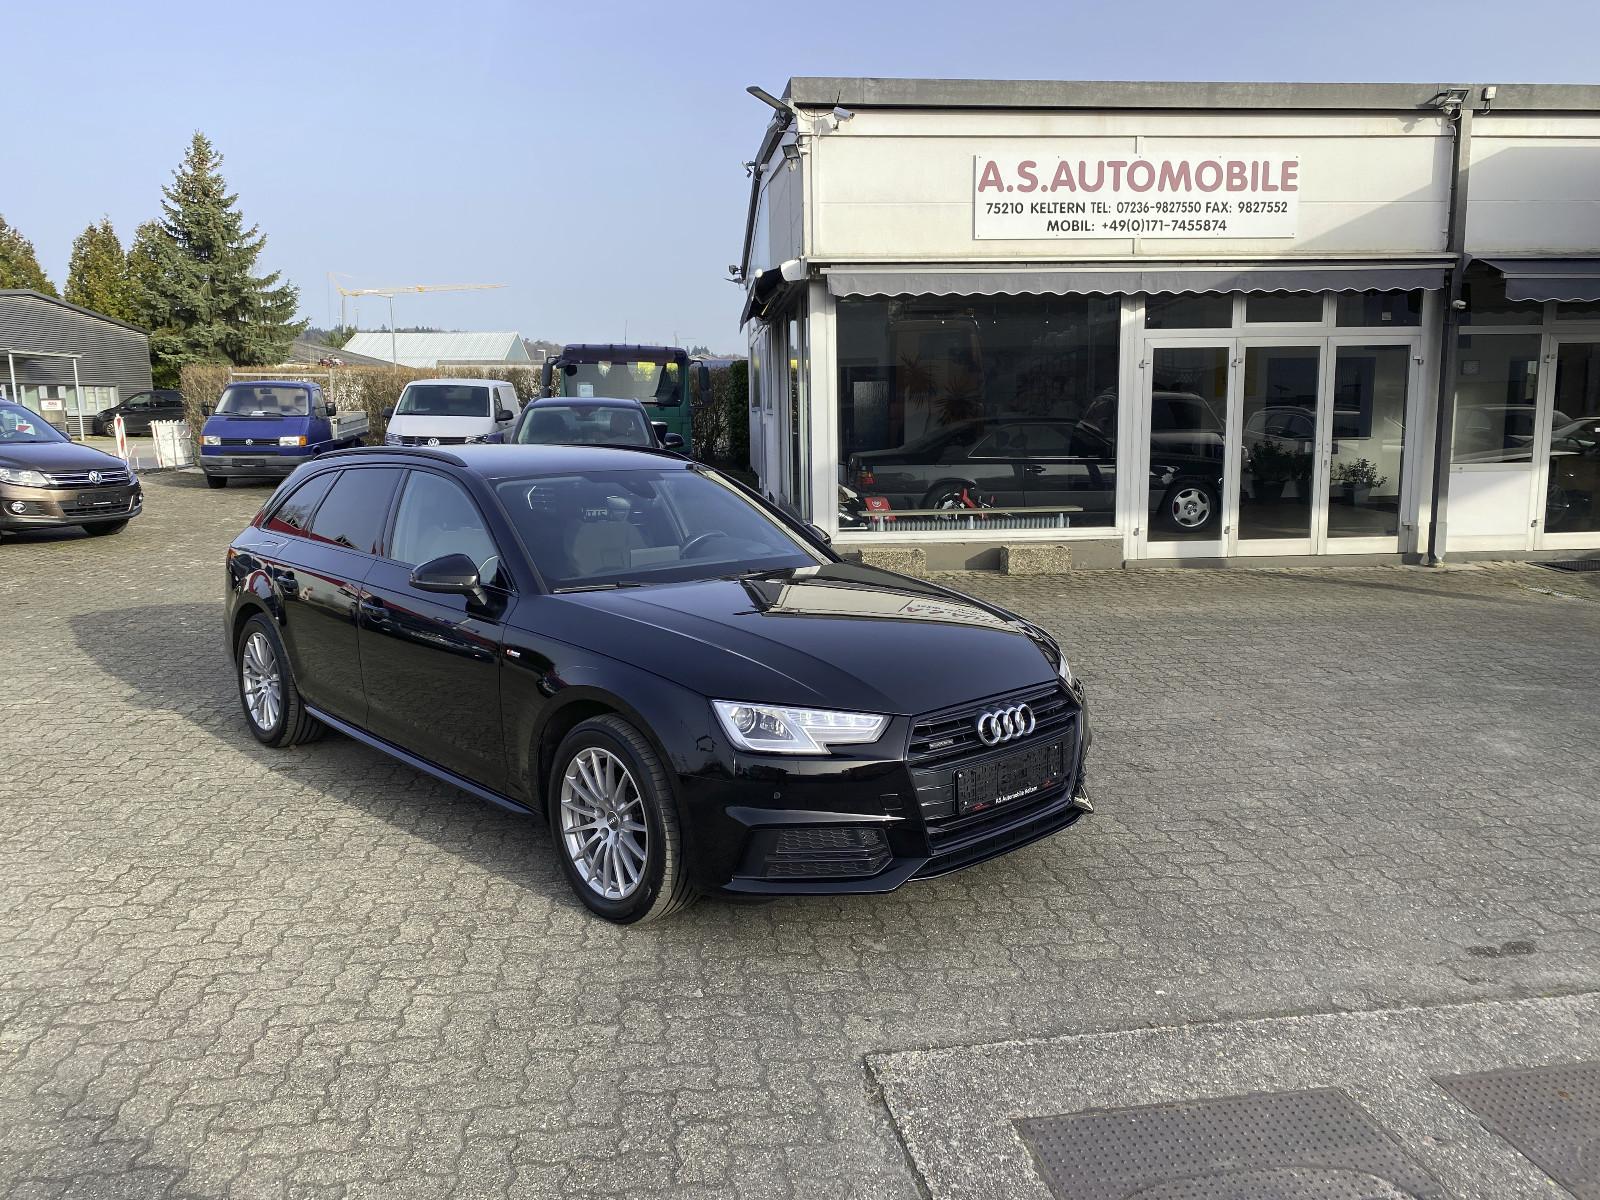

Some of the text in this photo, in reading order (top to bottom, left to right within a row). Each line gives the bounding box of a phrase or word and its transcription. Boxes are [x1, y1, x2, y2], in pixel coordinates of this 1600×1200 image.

[977, 160, 1298, 193] A.S.AUTOMOBILE
[986, 201, 1288, 214] 75210 KELTERN TEL: 07236-9827550 FAX: 9827552
[1046, 218, 1228, 233] MOBIL: +49(0)171-7455874
